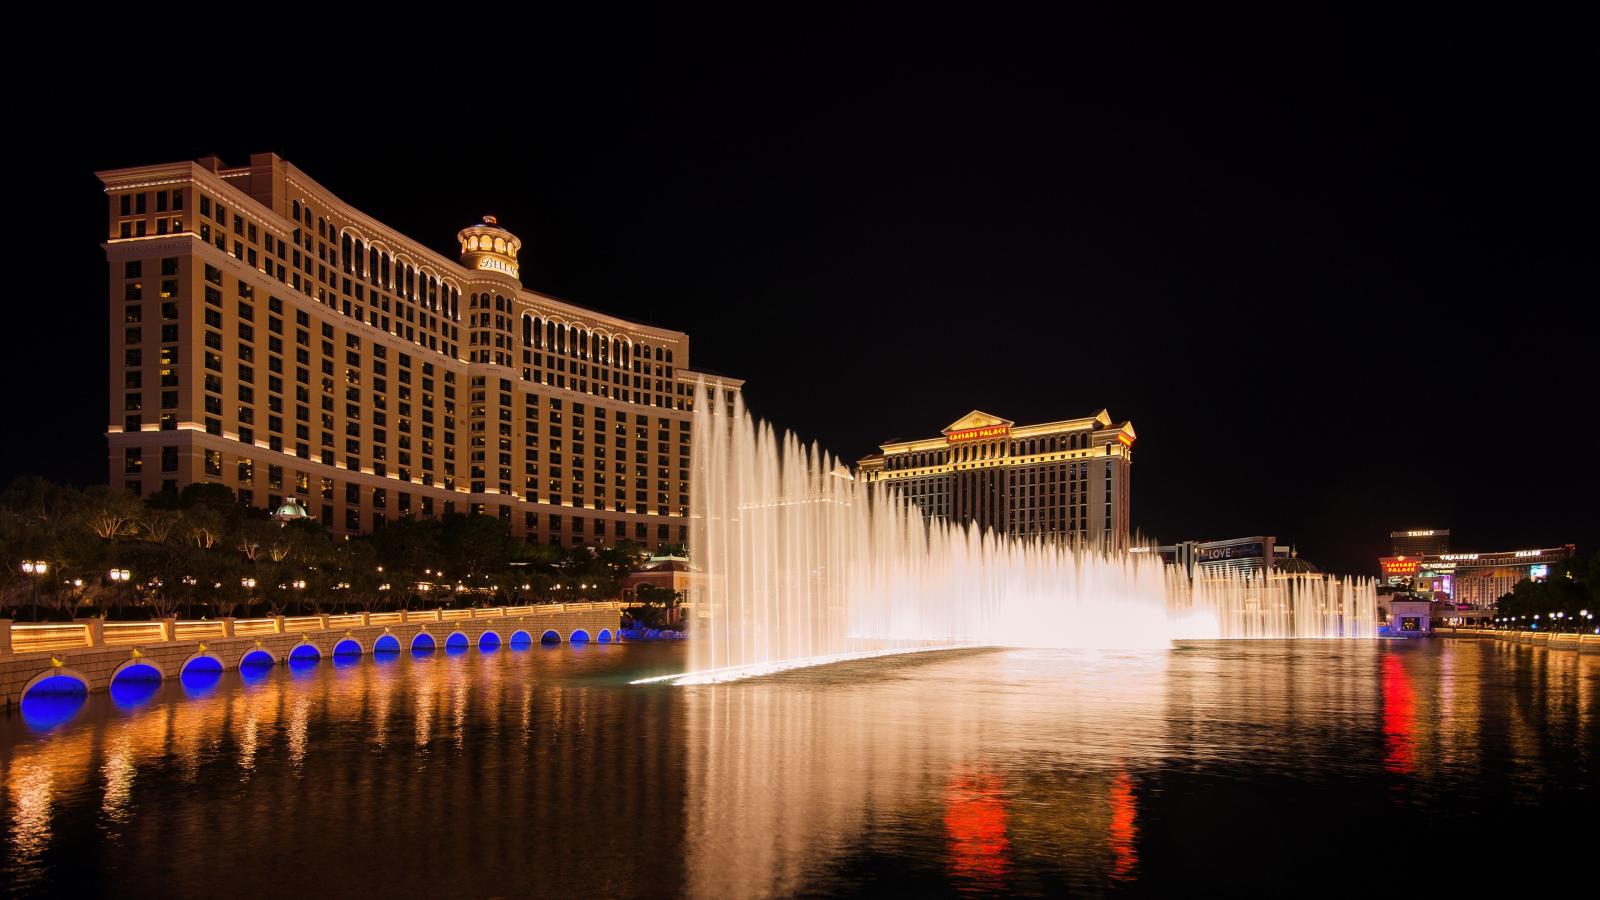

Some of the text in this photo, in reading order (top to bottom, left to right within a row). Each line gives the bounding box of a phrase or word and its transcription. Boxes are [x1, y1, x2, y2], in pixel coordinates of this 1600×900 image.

[949, 427, 1006, 441] CAESARS PALACE
[1208, 547, 1231, 560] LOVE
